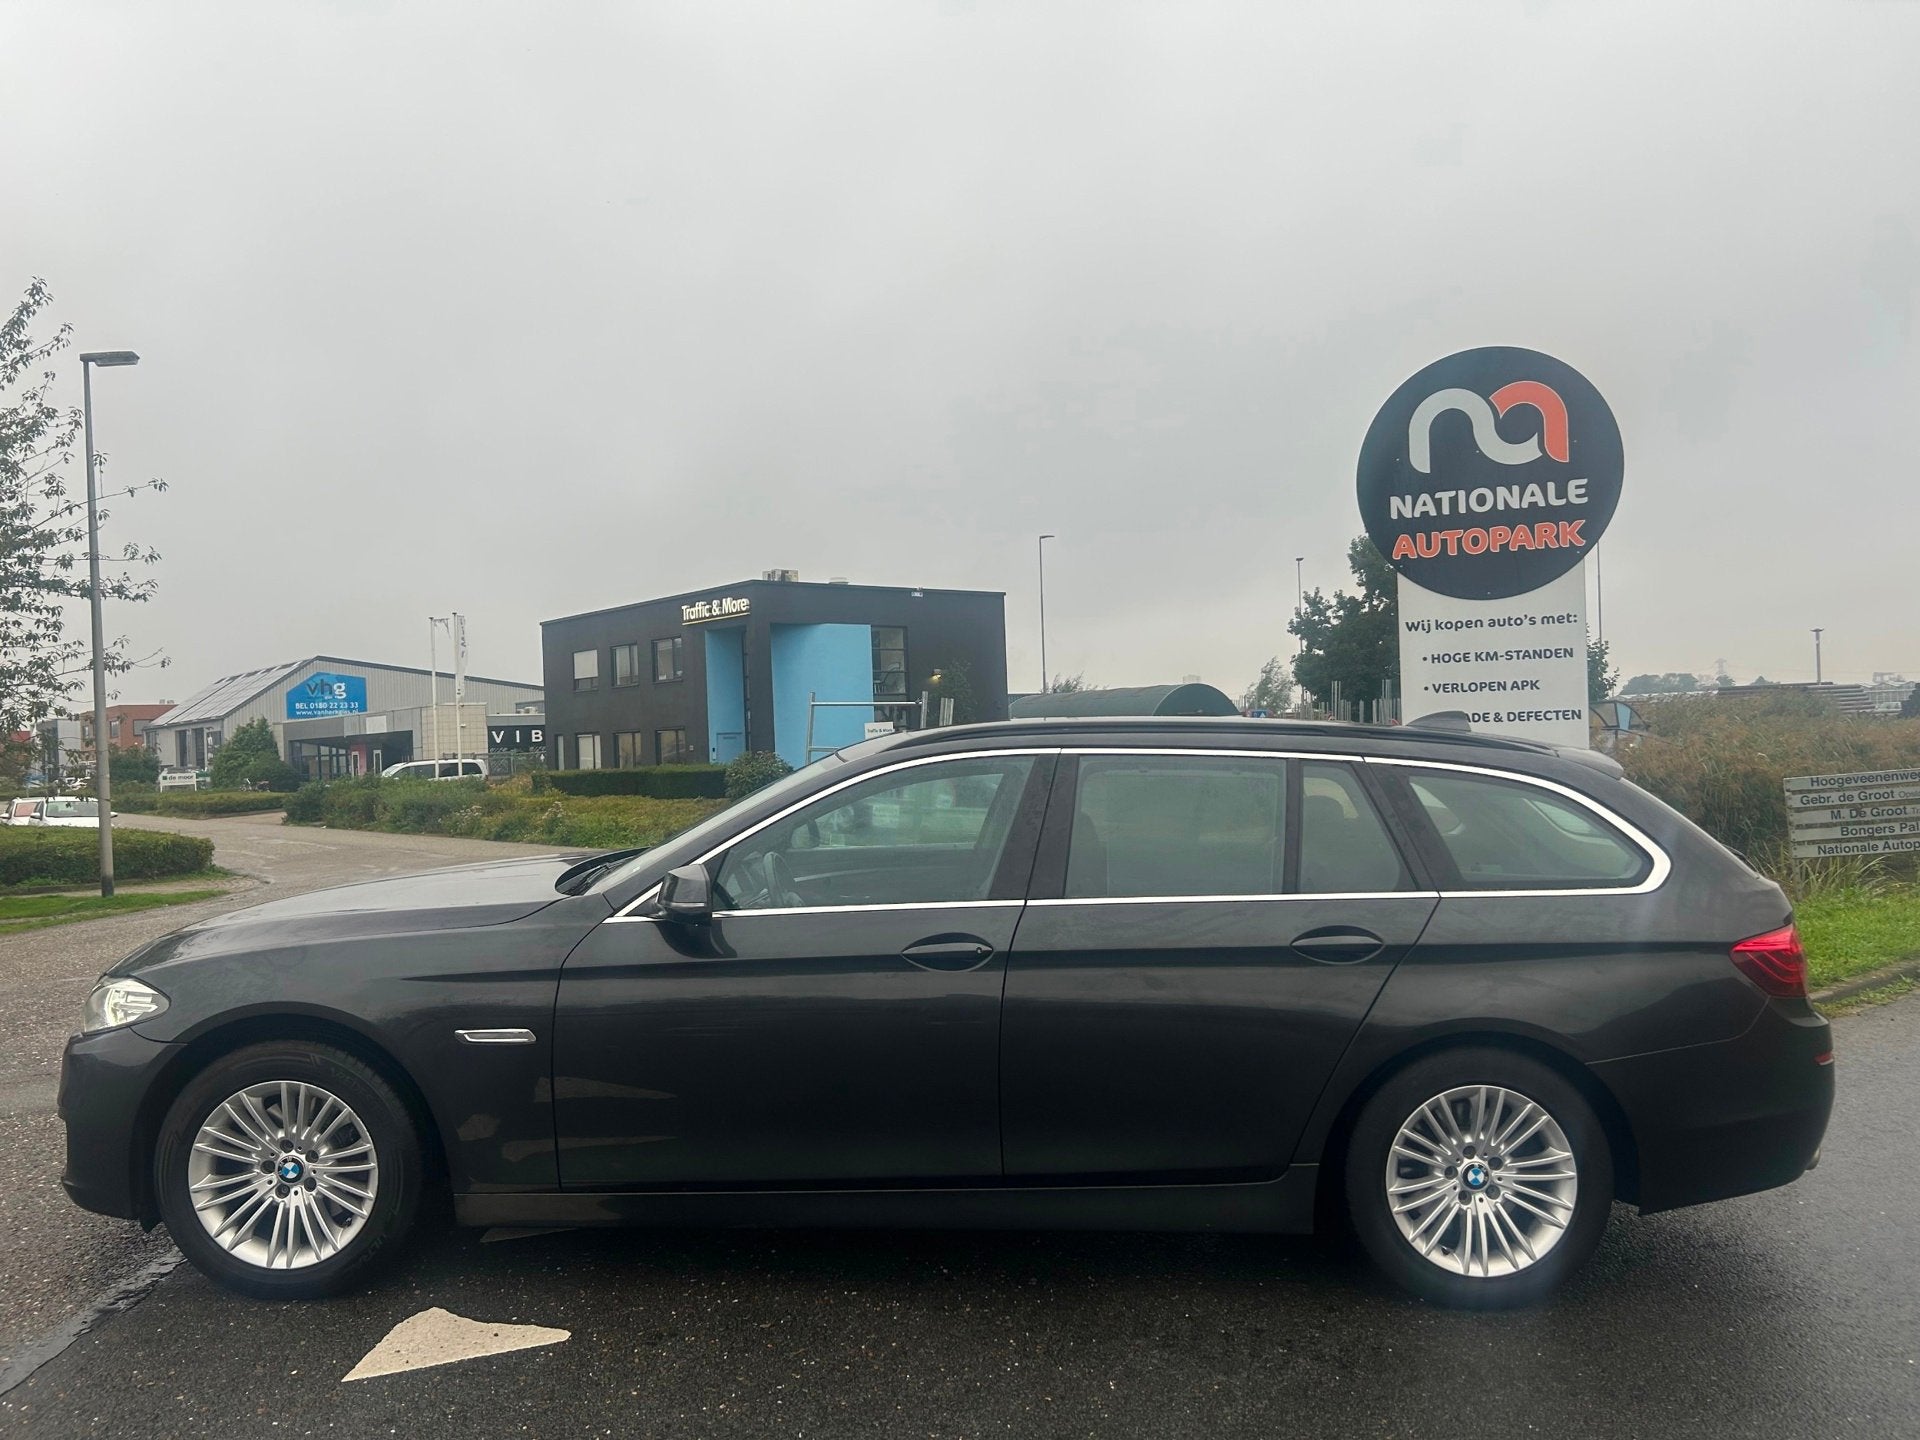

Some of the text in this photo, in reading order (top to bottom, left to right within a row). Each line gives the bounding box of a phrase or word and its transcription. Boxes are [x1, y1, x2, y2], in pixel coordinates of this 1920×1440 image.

[1390, 478, 1588, 519] NATIONALE
[1392, 519, 1586, 560] AUTOPARK
[681, 597, 750, 620] Traffic & More
[1405, 612, 1578, 634] Wij kopen auto's met:
[1430, 647, 1574, 664] HOGE KM-STANDEN
[306, 678, 347, 699] vhg
[1432, 679, 1540, 693] VERLOPEN APK
[1493, 712, 1504, 722] &
[1506, 709, 1582, 722] DEFECTEN
[1800, 794, 1835, 805] Gebr.
[1838, 792, 1855, 803] de
[1857, 790, 1895, 802] Groot
[1830, 810, 1846, 820] M.
[1849, 808, 1867, 819] De
[1870, 806, 1908, 818] Groot
[1840, 822, 1919, 839] Bongers Pal
[1817, 843, 1880, 856] Nationale
